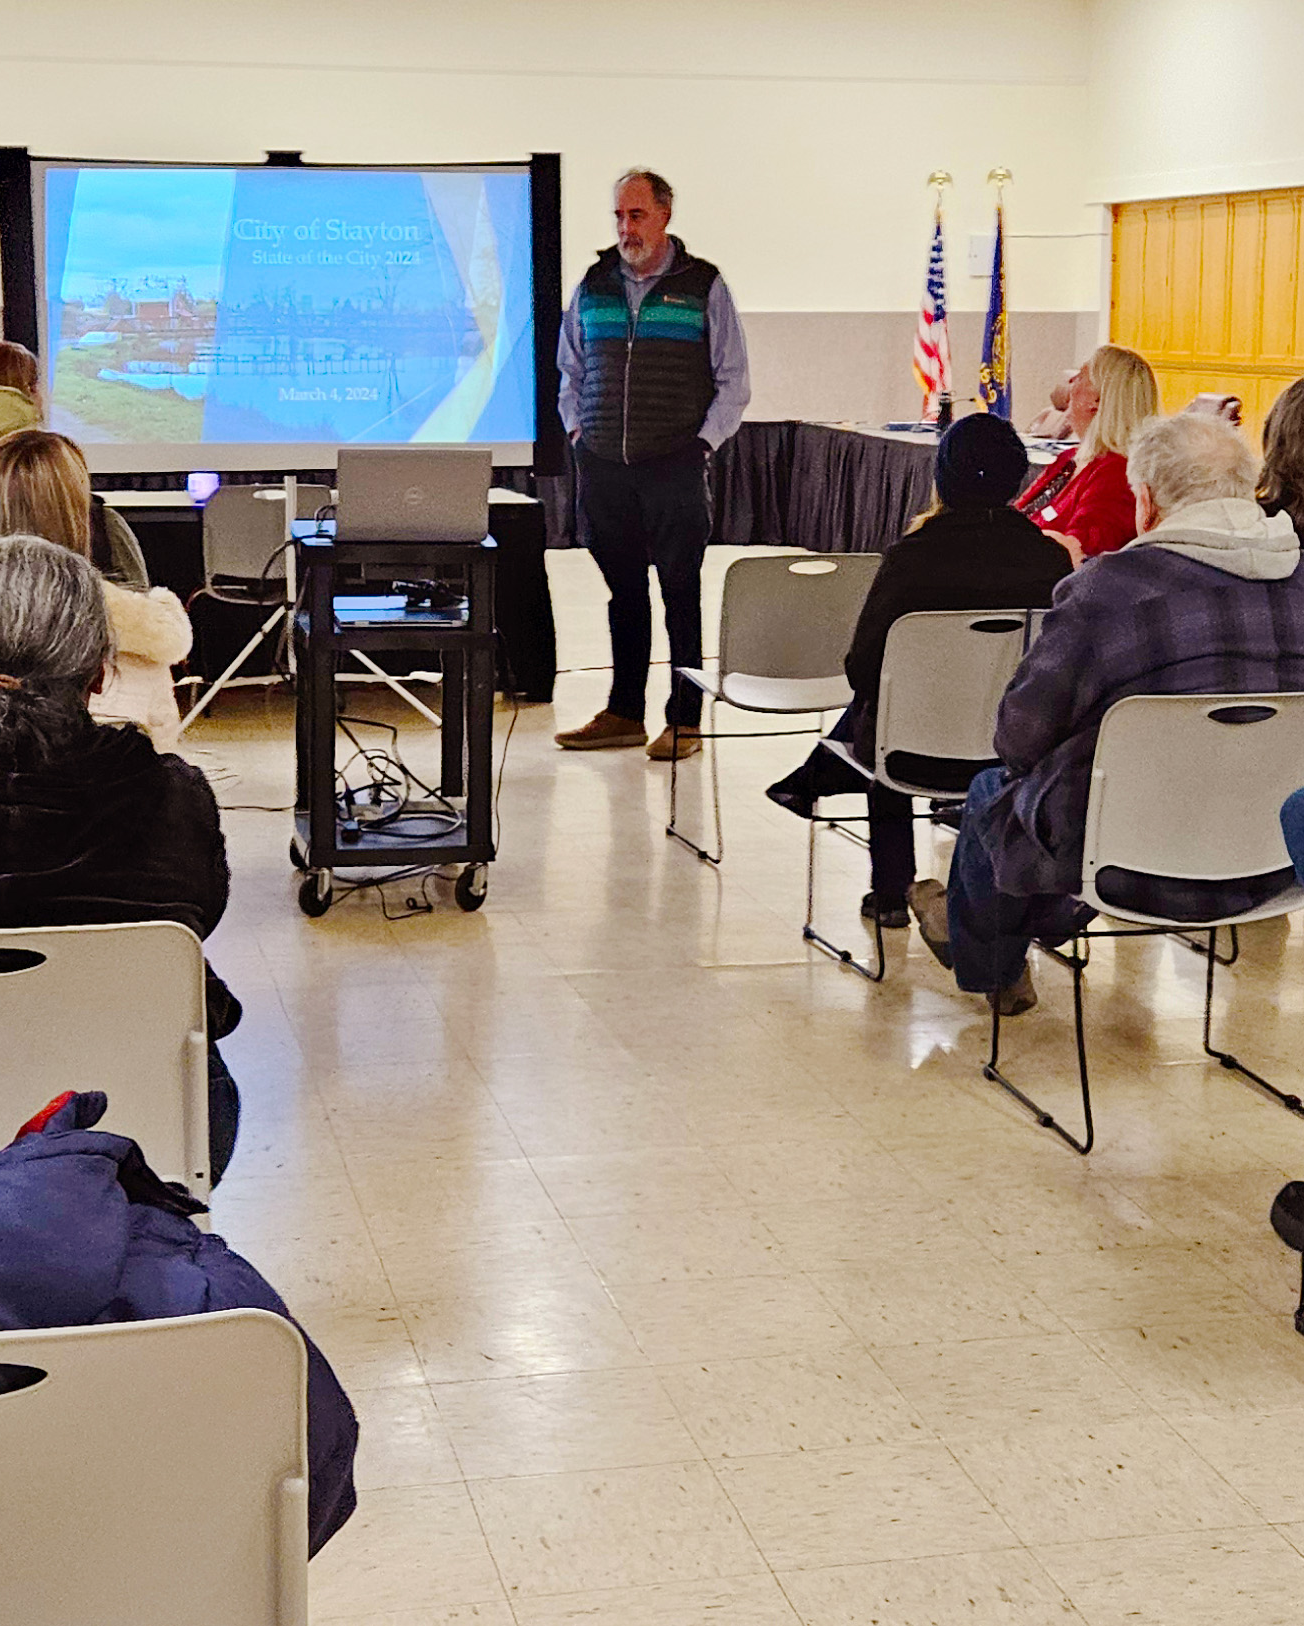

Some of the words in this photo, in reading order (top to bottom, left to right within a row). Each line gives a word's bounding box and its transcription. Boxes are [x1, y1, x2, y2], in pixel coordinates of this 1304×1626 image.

[234, 218, 288, 248] City
[294, 218, 321, 241] of
[326, 219, 421, 248] Stayton
[252, 250, 292, 265] State
[296, 250, 313, 265] of
[316, 250, 342, 265] the
[347, 250, 381, 270] City
[279, 387, 326, 401] March
[330, 387, 342, 403] 4,
[345, 387, 378, 401] 2024
